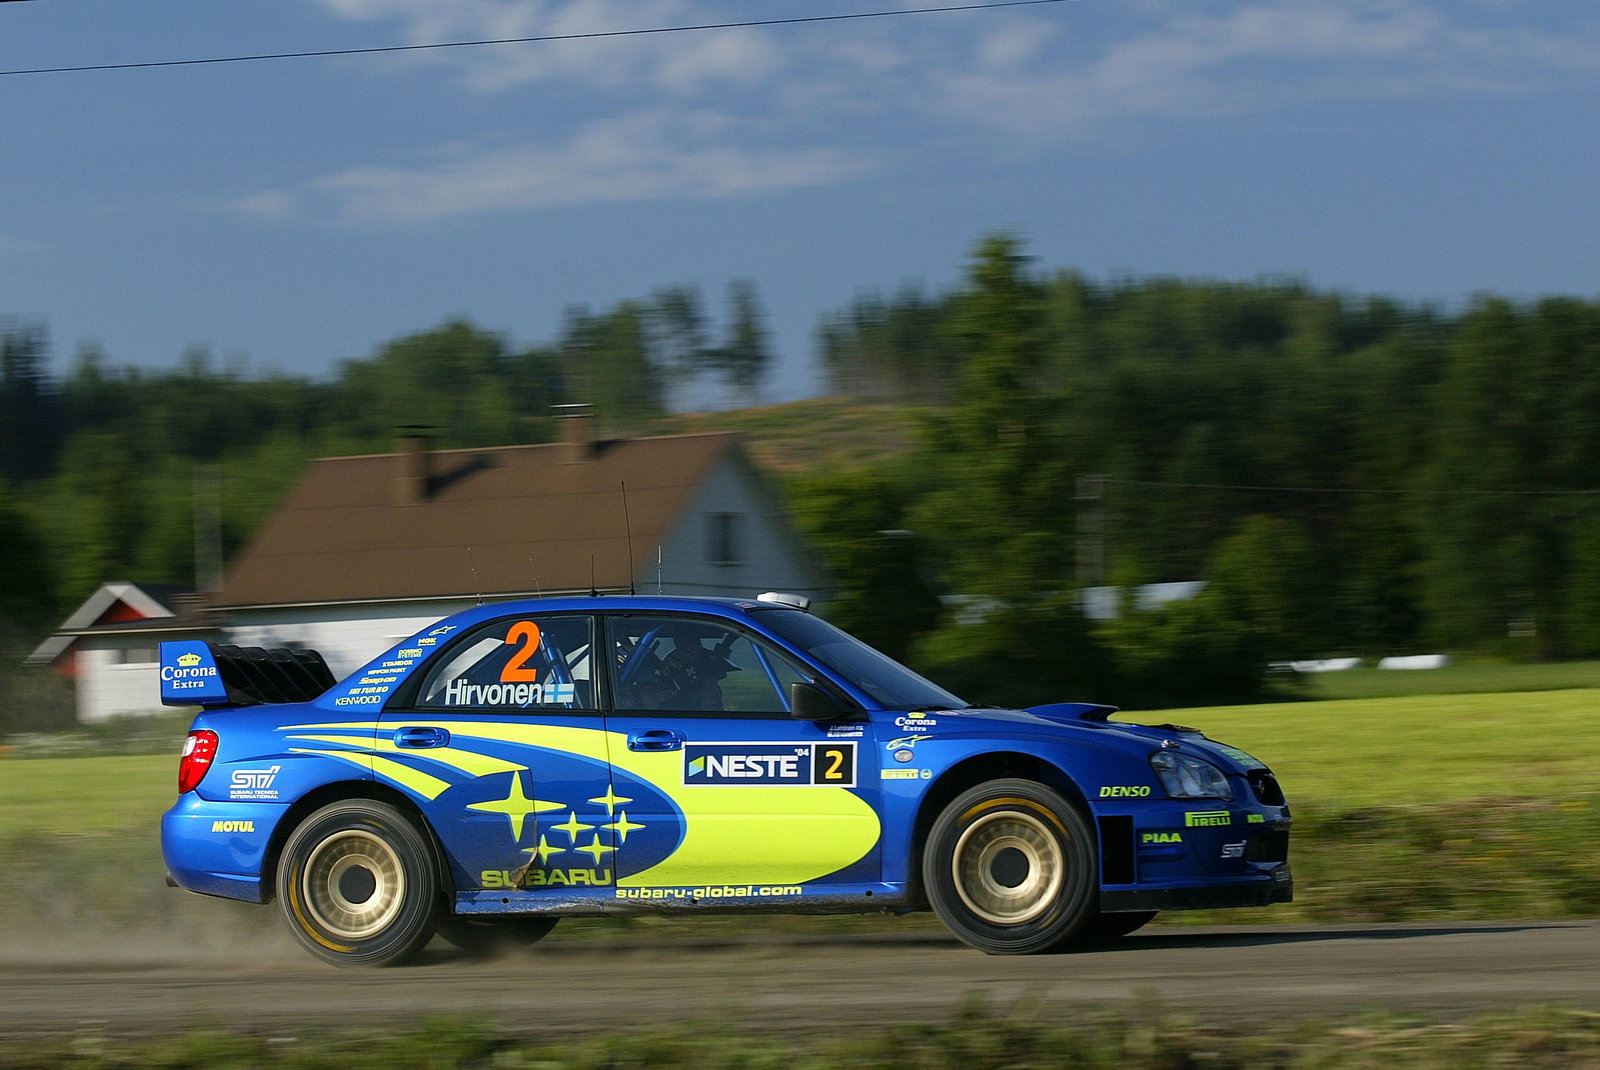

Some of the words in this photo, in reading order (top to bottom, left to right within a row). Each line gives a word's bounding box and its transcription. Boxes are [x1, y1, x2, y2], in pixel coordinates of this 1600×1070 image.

[500, 620, 541, 683] 2
[161, 666, 217, 681] Corona
[173, 680, 204, 689] Extra
[361, 685, 389, 694] TURBO
[445, 679, 542, 705] Hirvonen
[335, 695, 381, 706] KENWOOD
[895, 716, 937, 726] Corona
[706, 755, 799, 778] NESTE
[825, 750, 844, 780] 2
[1099, 786, 1151, 798] DENSO
[1184, 810, 1232, 827] PIRELLI
[211, 821, 255, 833] MOTUL
[1142, 833, 1183, 843] PIAA
[481, 869, 612, 888] SUBARU
[615, 885, 802, 899] subaru-global.com
